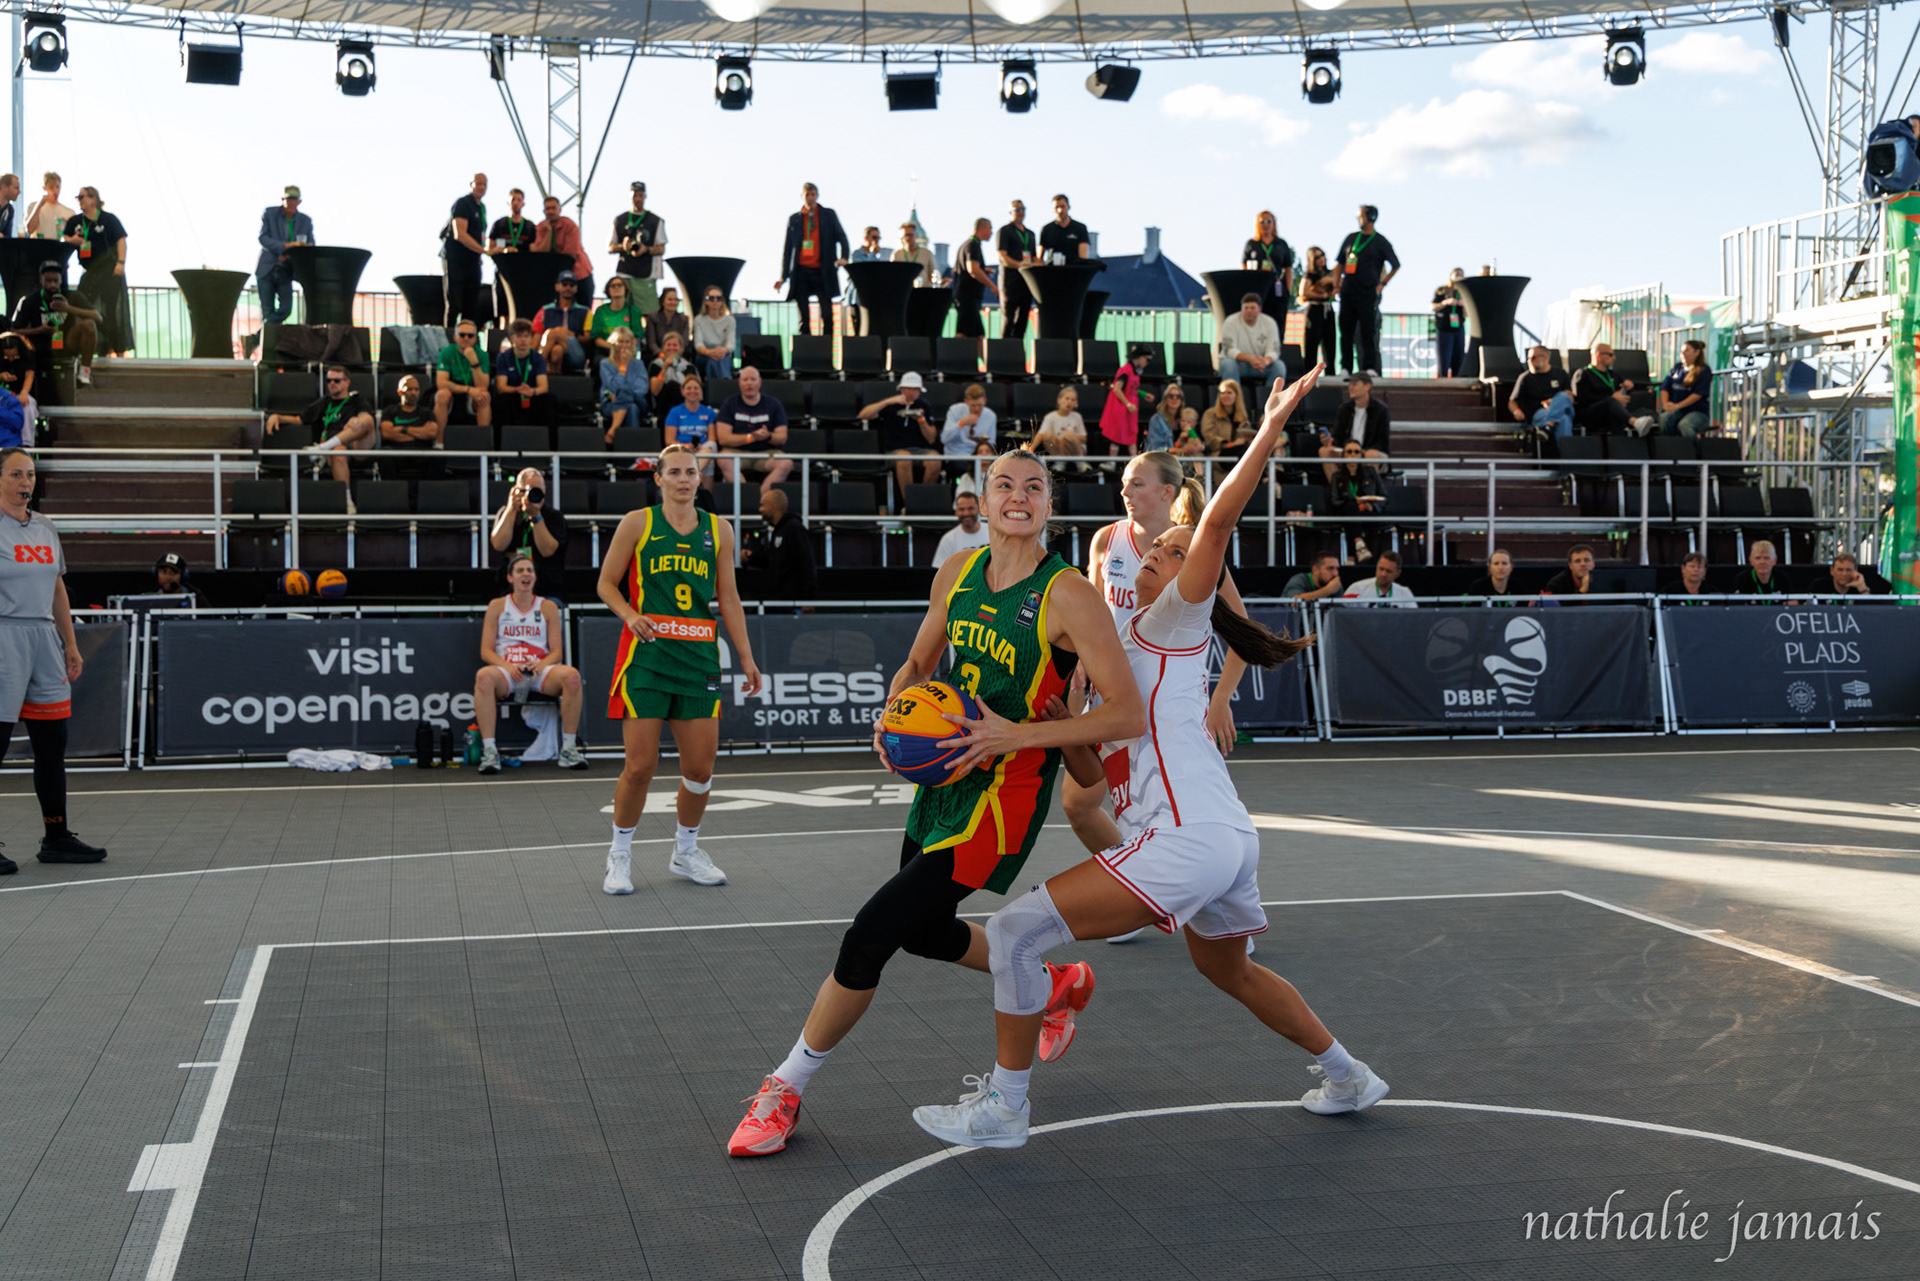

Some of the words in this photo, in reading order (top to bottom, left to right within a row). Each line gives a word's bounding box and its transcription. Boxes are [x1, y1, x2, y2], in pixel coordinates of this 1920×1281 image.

[650, 555, 708, 580] LIETUVA
[675, 584, 692, 611] 9
[1109, 585, 1137, 610] AUS
[503, 625, 541, 637] AUSTRIA
[1776, 612, 1861, 634] OFELIA
[308, 637, 415, 675] visit
[1785, 641, 1861, 664] PLADS
[960, 663, 981, 700] 3
[1443, 689, 1497, 706] DBBF
[201, 686, 511, 734] copenhage
[754, 708, 820, 726] SPORT
[828, 708, 843, 725] &
[1505, 710, 1536, 718] Federation
